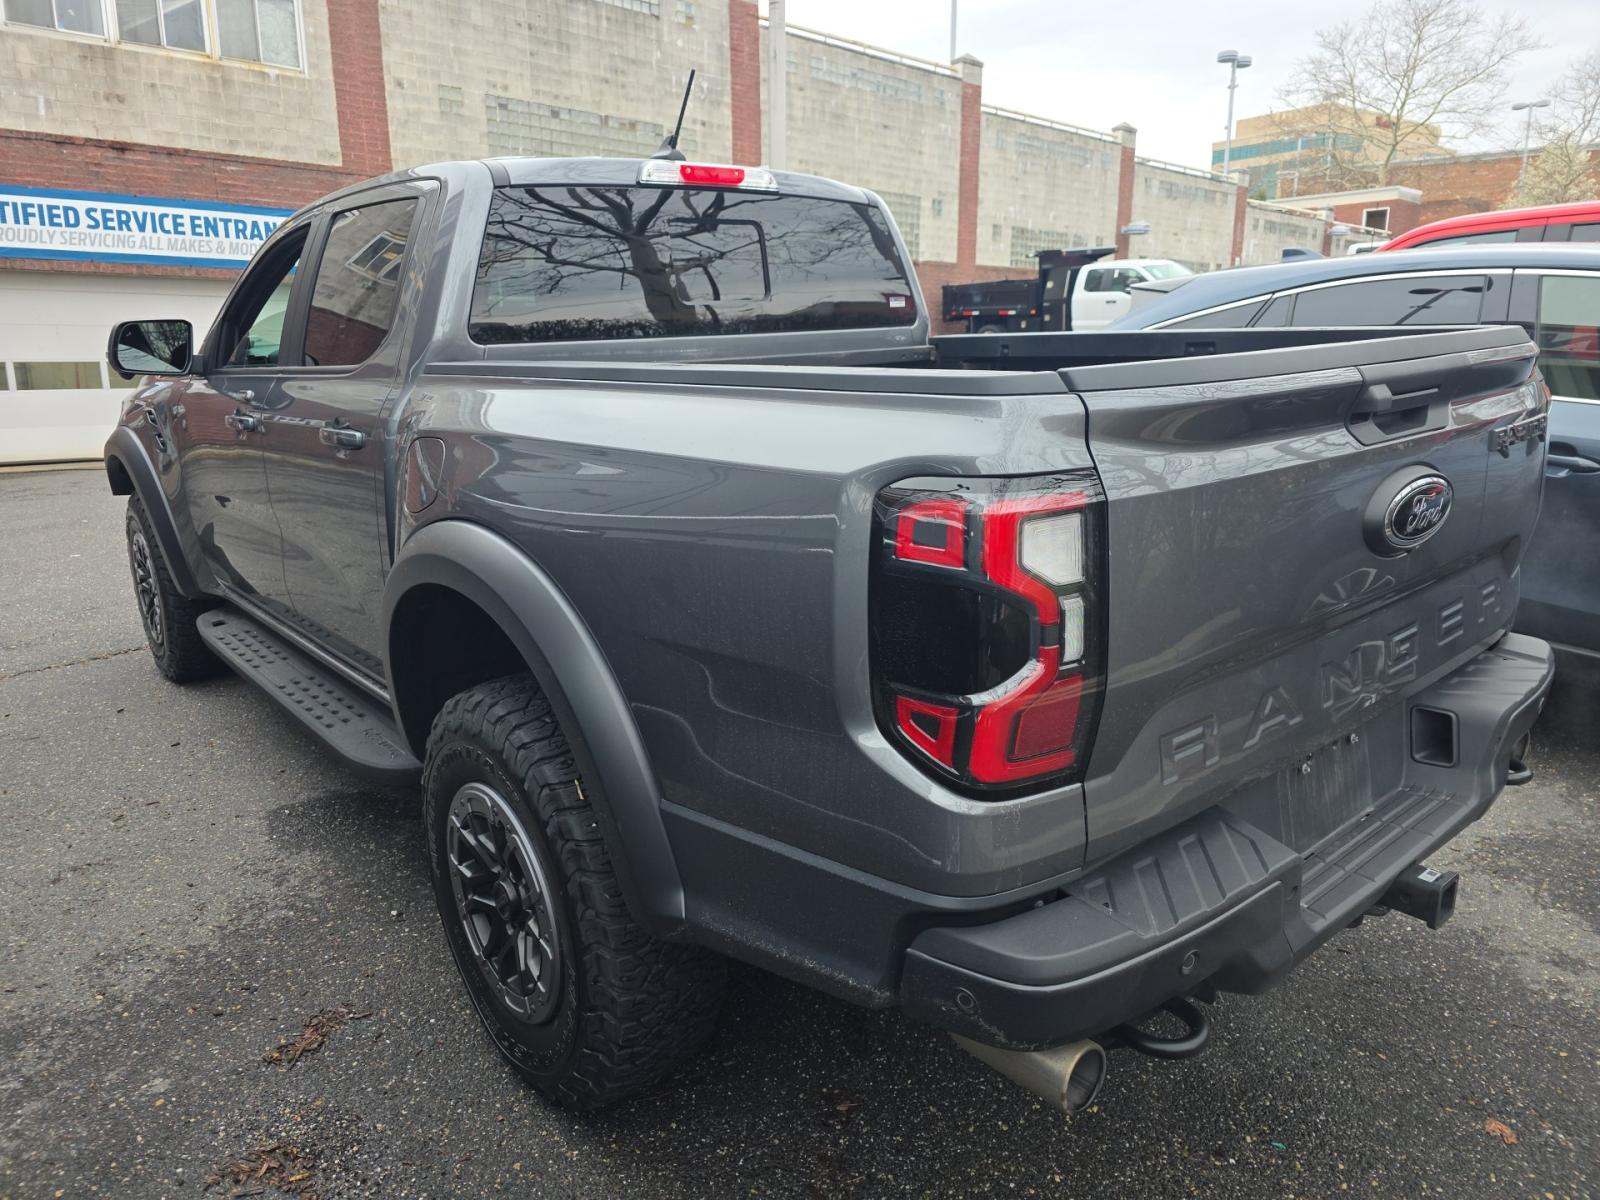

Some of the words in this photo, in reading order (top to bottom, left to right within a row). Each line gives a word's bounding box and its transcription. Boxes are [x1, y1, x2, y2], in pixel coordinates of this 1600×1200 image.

[0, 201, 80, 228] TIFIED
[85, 207, 186, 235] SERVICE
[189, 215, 277, 241] ENTRAN
[60, 230, 136, 249] SERVICING
[139, 235, 165, 251] ALL
[167, 238, 213, 253] MAKES
[216, 240, 226, 254] &
[1158, 578, 1502, 787] RANGER
